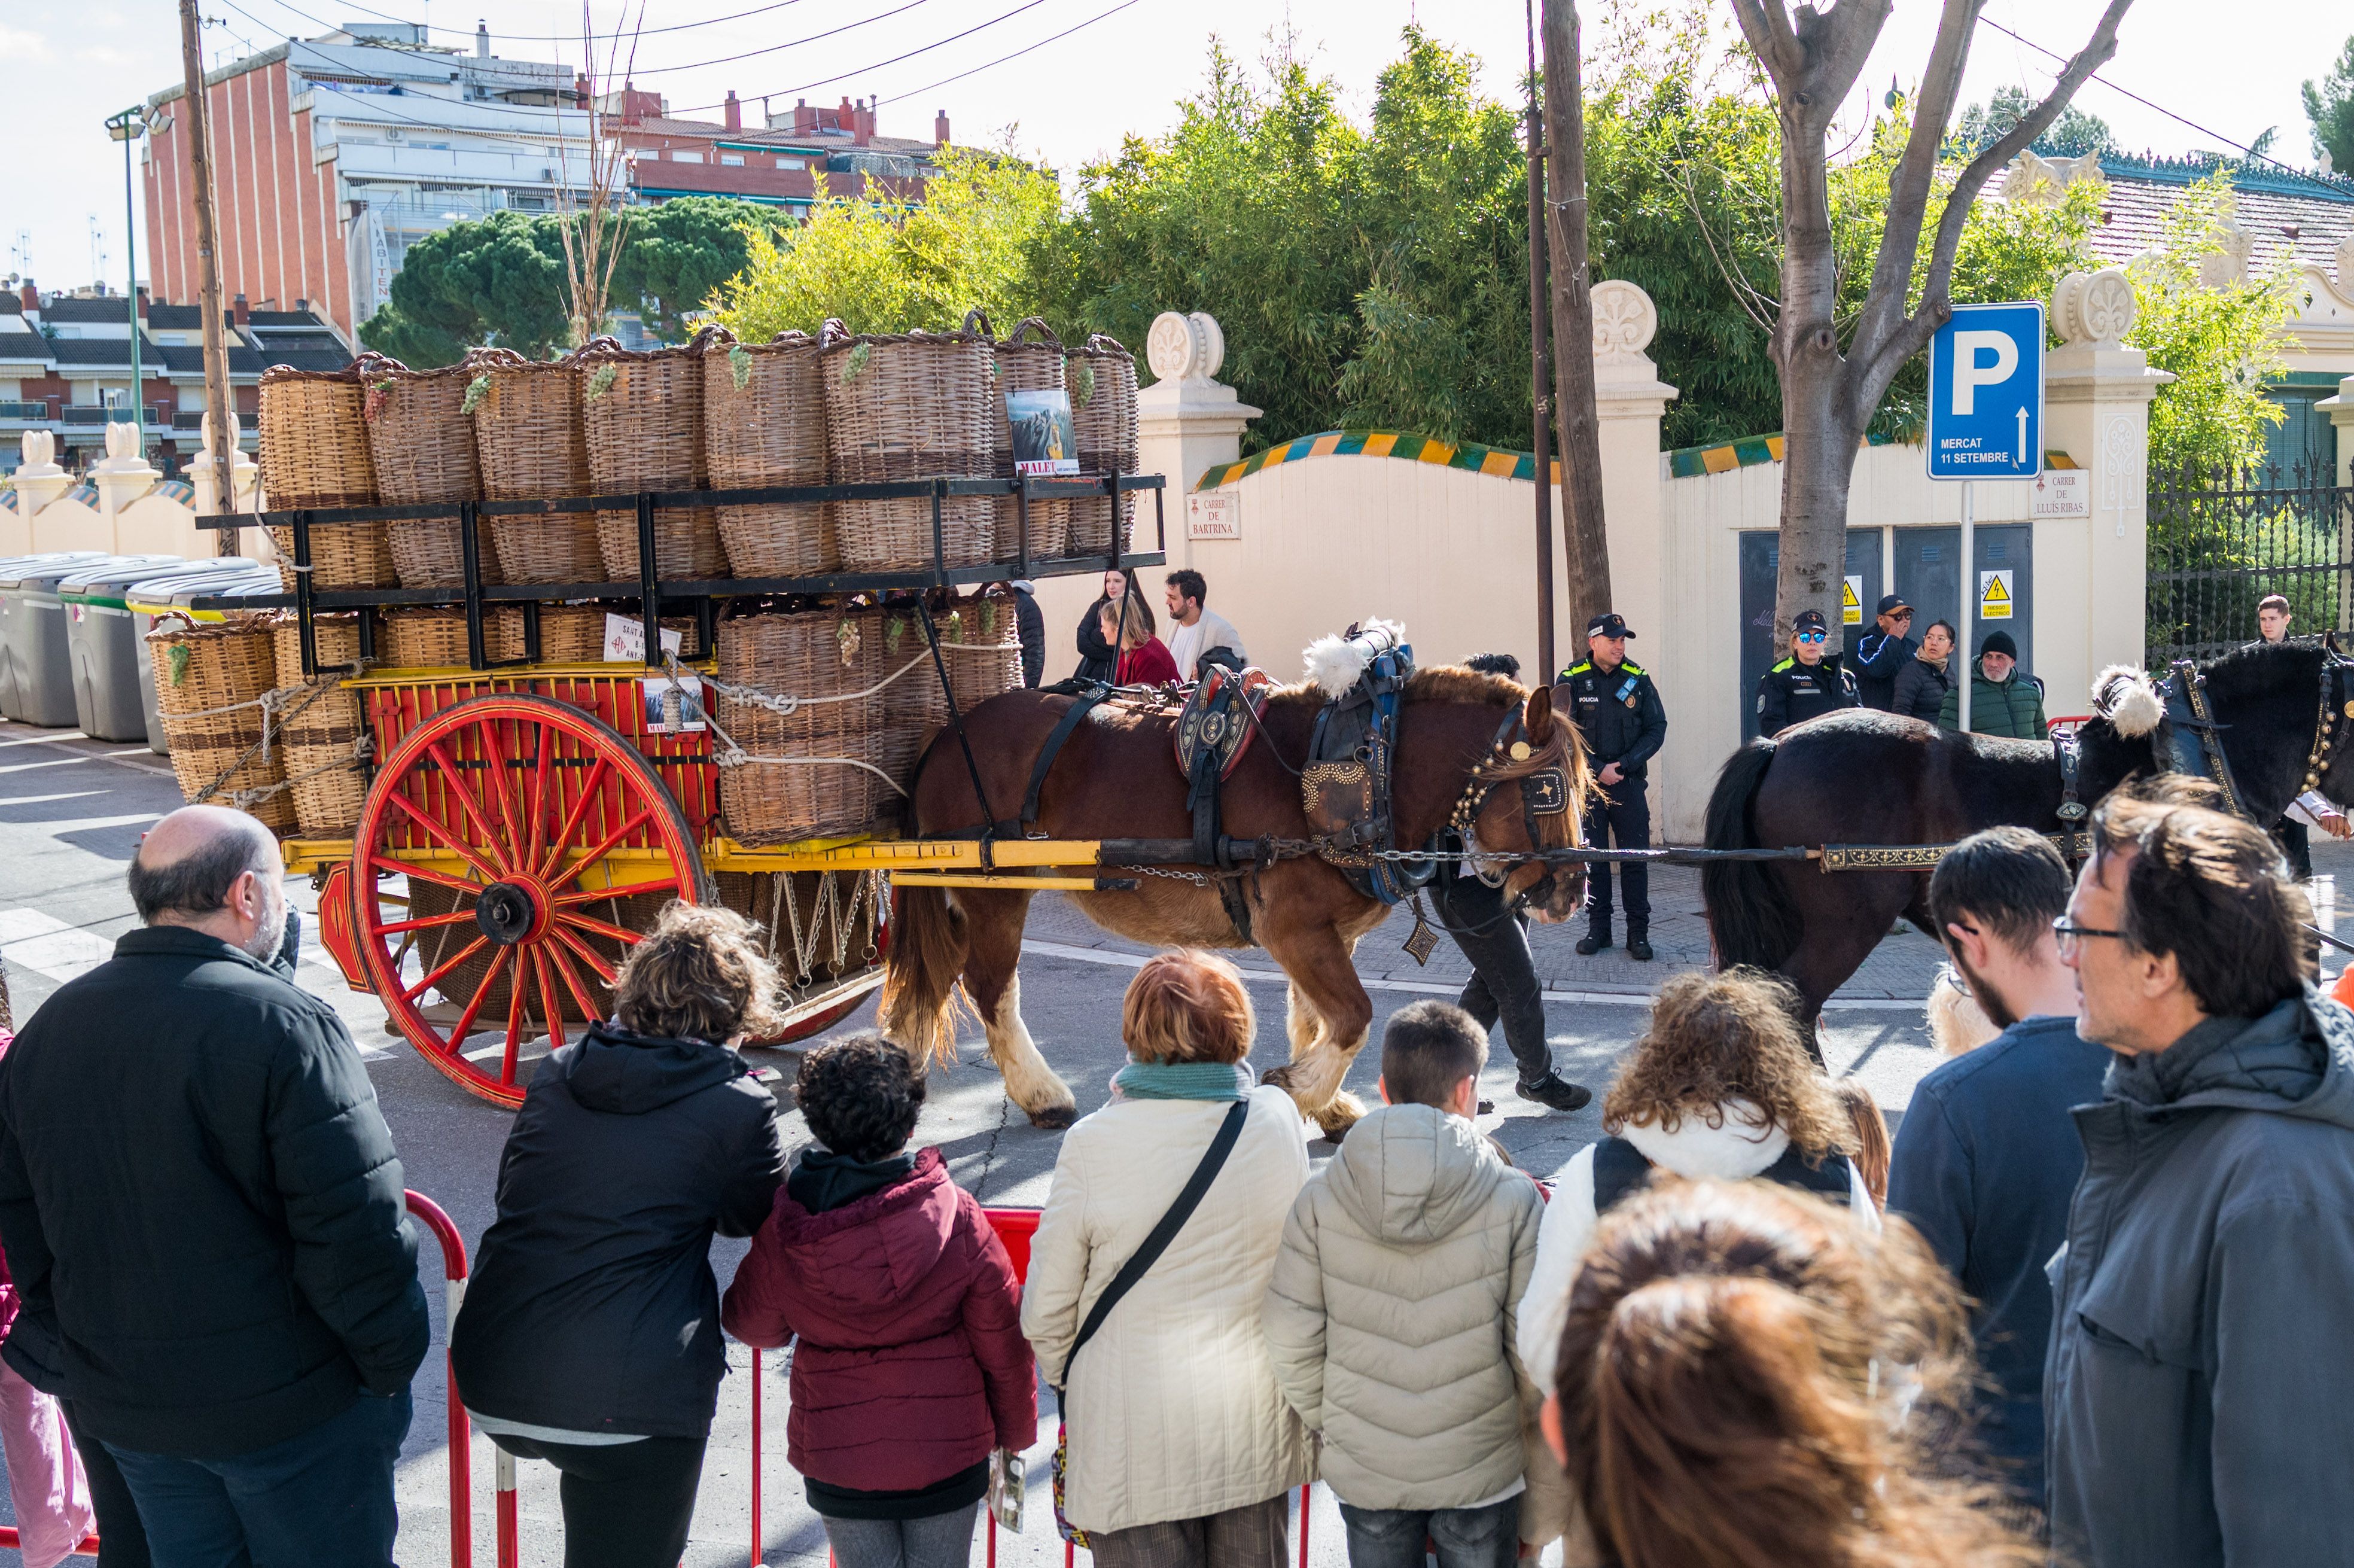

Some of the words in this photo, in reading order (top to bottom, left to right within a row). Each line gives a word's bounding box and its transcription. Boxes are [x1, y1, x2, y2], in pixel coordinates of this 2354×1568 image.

[1952, 330, 2018, 415] P
[1941, 438, 1982, 449] MERCAT
[1941, 453, 1951, 464] 11
[1954, 452, 2008, 463] SETEMBRE
[1020, 461, 1056, 473] MALET
[2052, 477, 2075, 486] CARRER
[2056, 490, 2067, 498] DE
[1204, 500, 1226, 509] CARRER
[2037, 501, 2058, 513] LLUÍS
[2061, 503, 2083, 513] RIBAS
[1208, 511, 1219, 520] DE
[1193, 523, 1232, 534] BARTRINA
[623, 625, 638, 637] SANT
[626, 650, 645, 661] ANY-2
